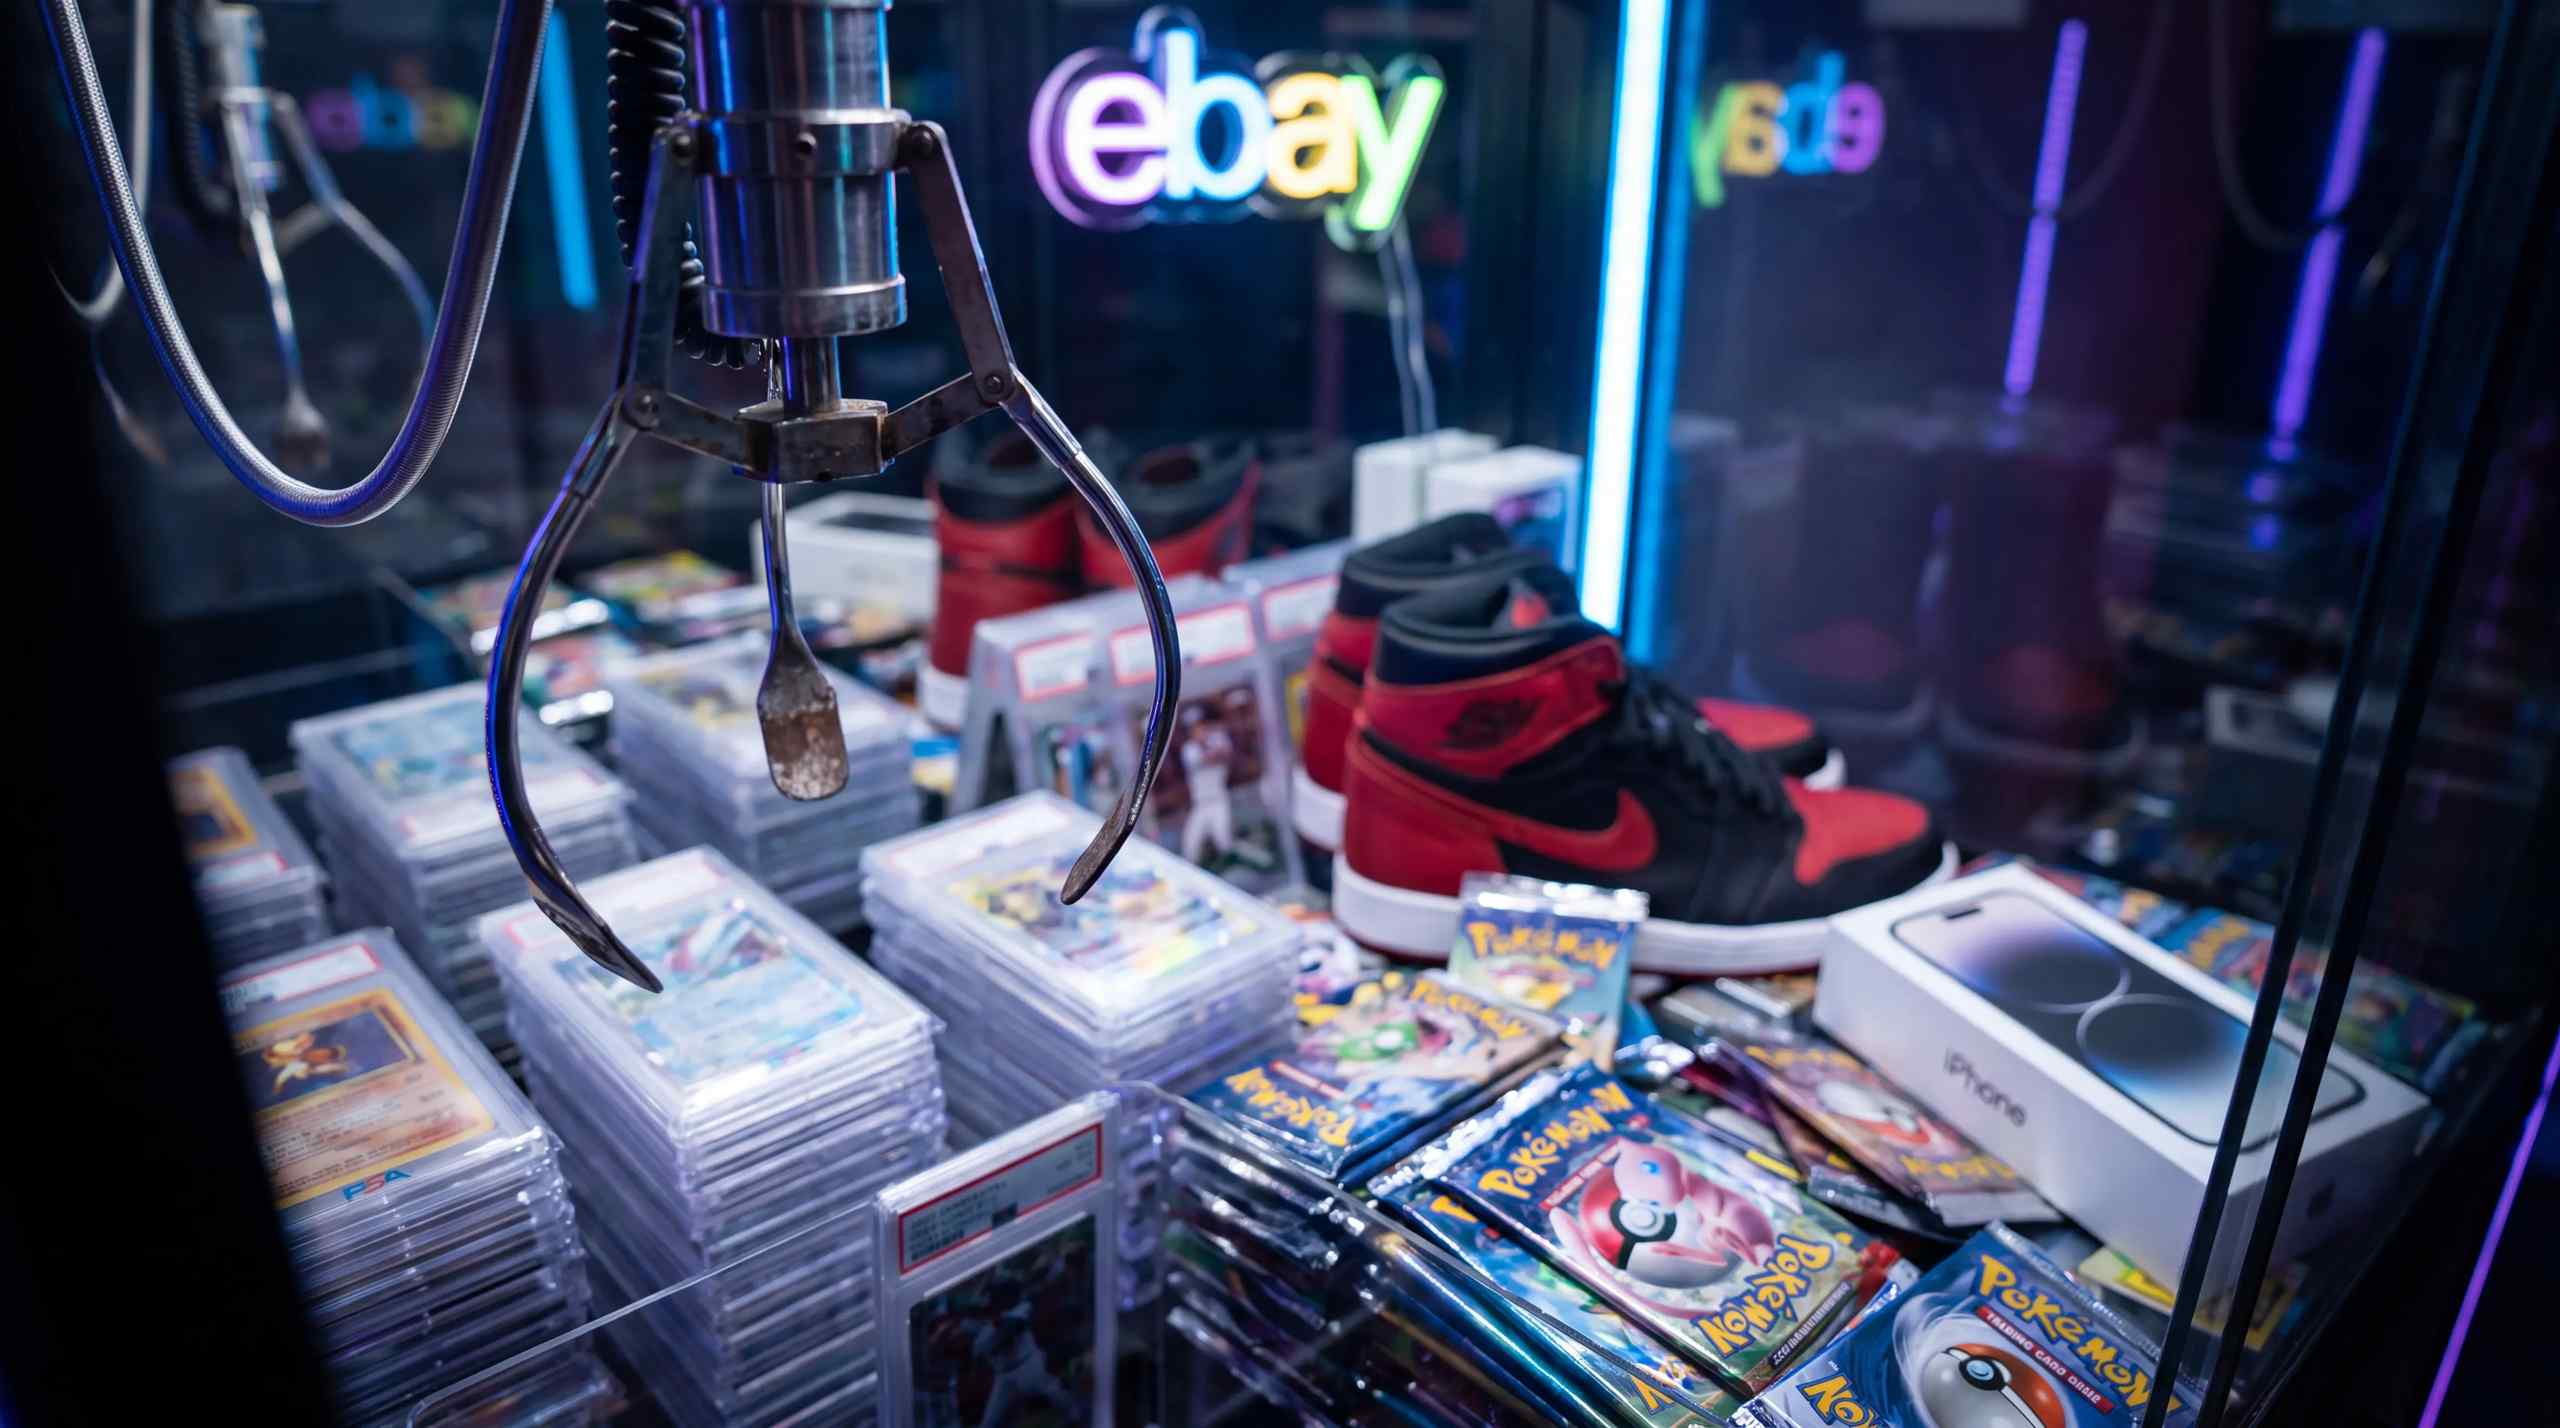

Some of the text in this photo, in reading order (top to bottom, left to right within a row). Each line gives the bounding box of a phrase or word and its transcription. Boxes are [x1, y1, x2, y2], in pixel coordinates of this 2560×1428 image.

[1063, 29, 1443, 230] ebay
[1943, 1046, 2026, 1128] iPhone
[343, 1168, 411, 1200] PSA
